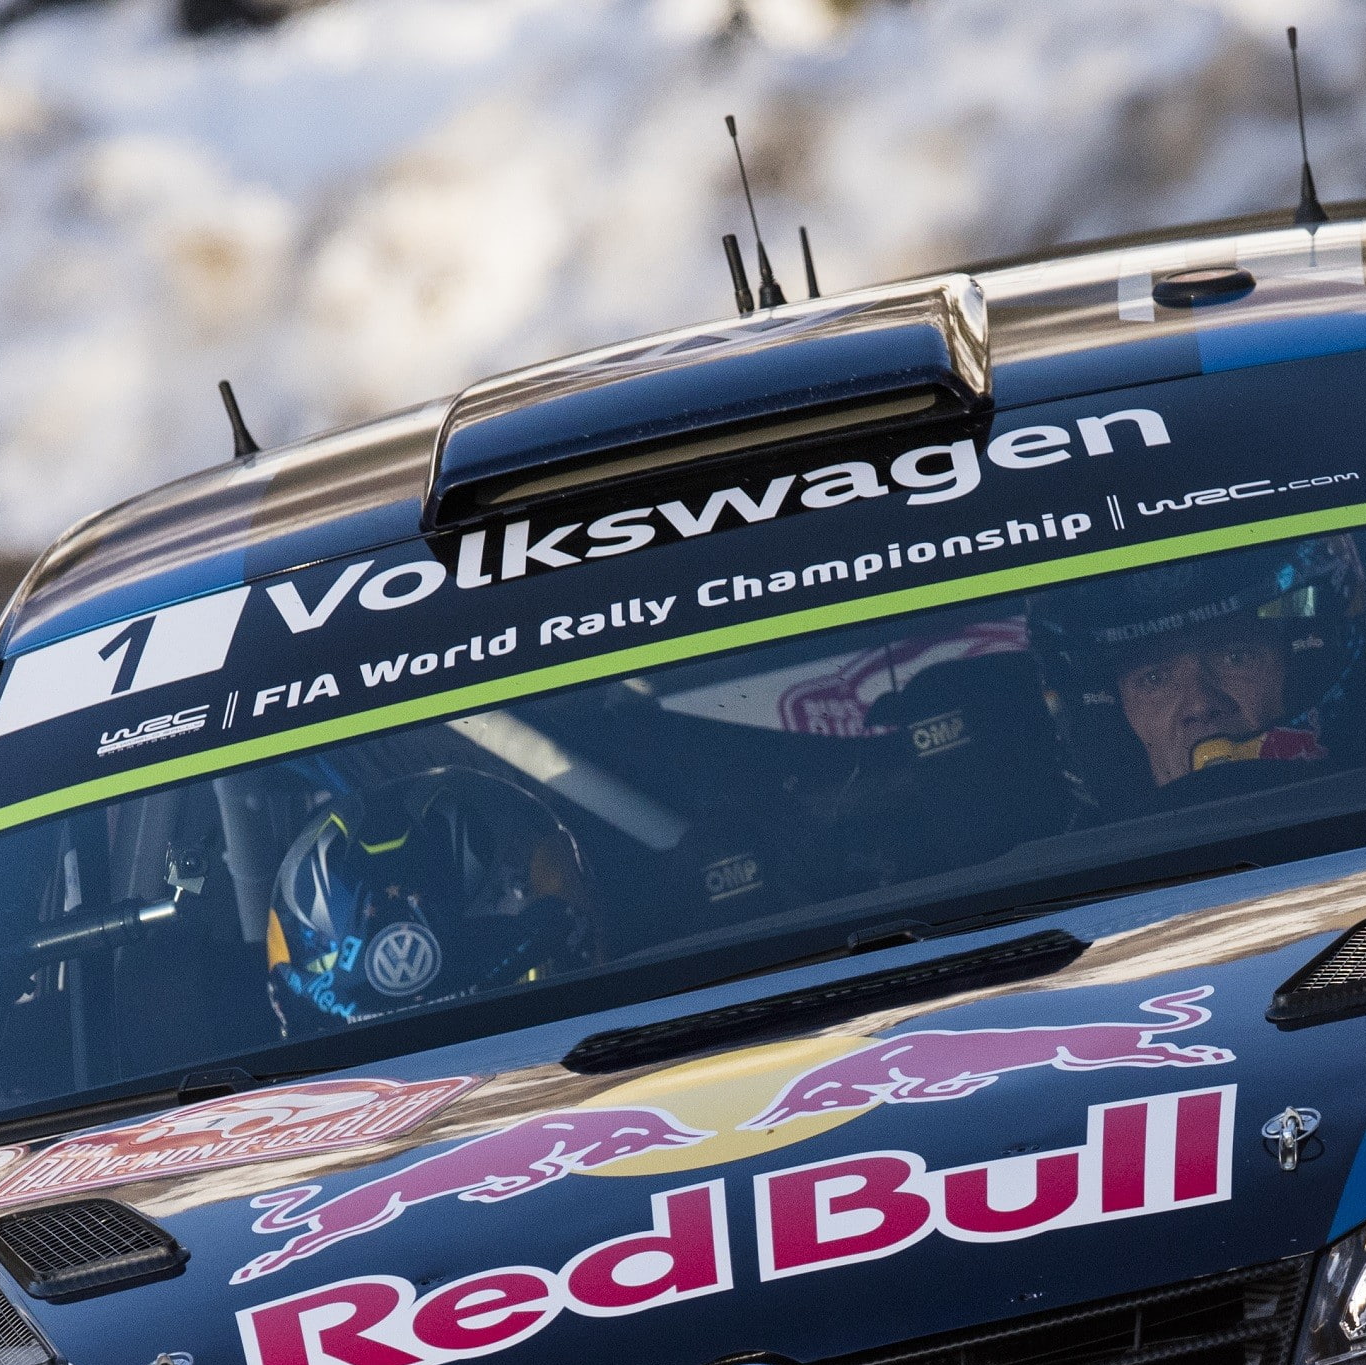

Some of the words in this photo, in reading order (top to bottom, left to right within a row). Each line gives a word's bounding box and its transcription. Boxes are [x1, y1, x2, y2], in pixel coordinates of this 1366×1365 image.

[252, 673, 341, 717] FIA
[361, 626, 517, 687] World
[538, 593, 678, 648] Rally
[696, 510, 1093, 610] Championship
[264, 408, 1172, 635] Volkswagen
[97, 614, 157, 696] 1
[766, 1090, 1229, 1270] Bull
